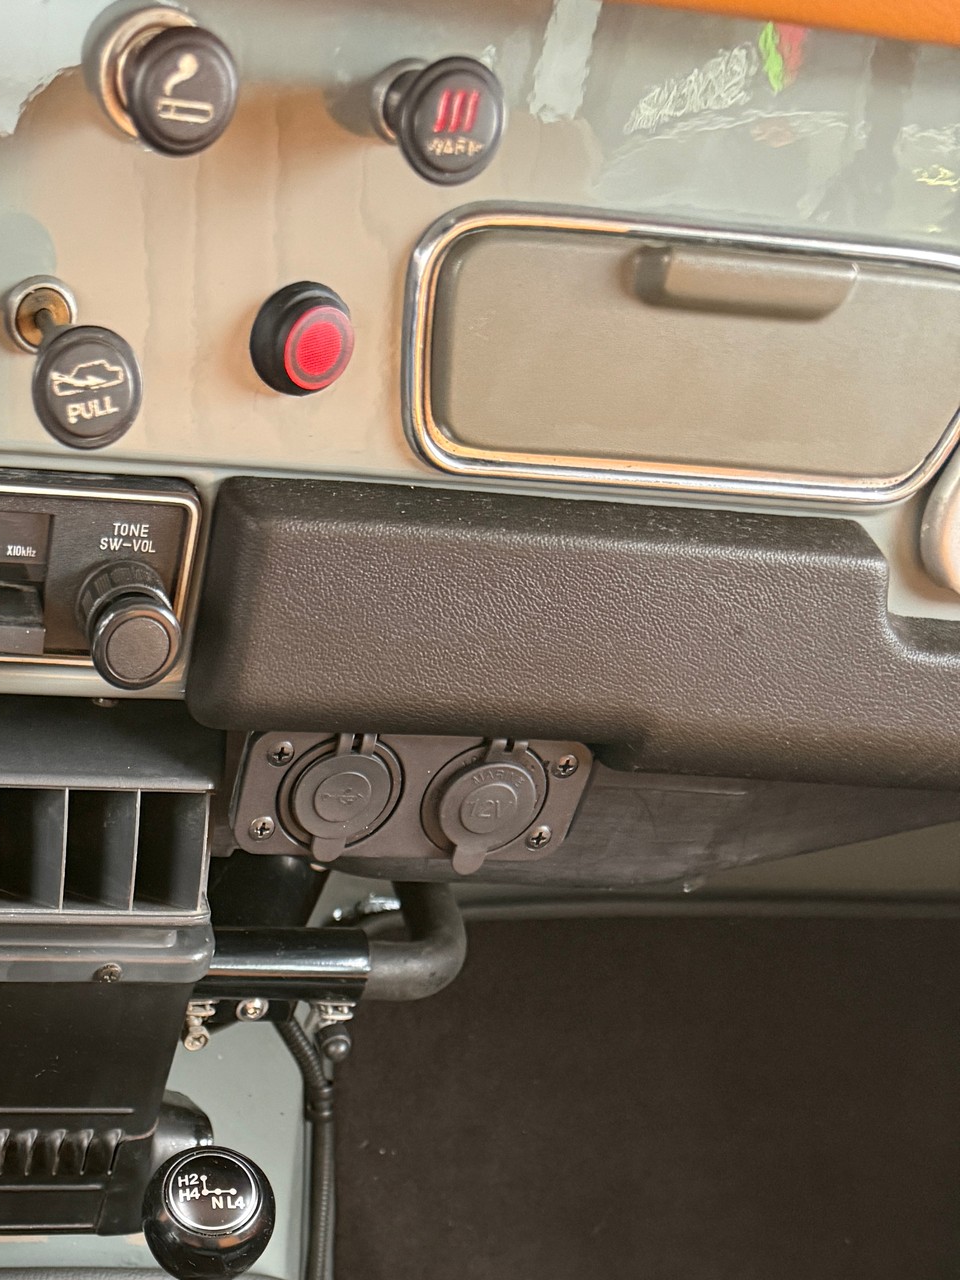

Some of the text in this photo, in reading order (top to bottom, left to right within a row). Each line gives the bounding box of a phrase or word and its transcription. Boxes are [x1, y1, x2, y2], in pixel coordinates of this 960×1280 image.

[66, 396, 120, 424] PULL
[113, 523, 149, 538] TONE
[99, 537, 156, 553] SW-VOL
[177, 1173, 200, 1188] H2
[178, 1187, 200, 1203] H4
[211, 1195, 246, 1210] N L4
